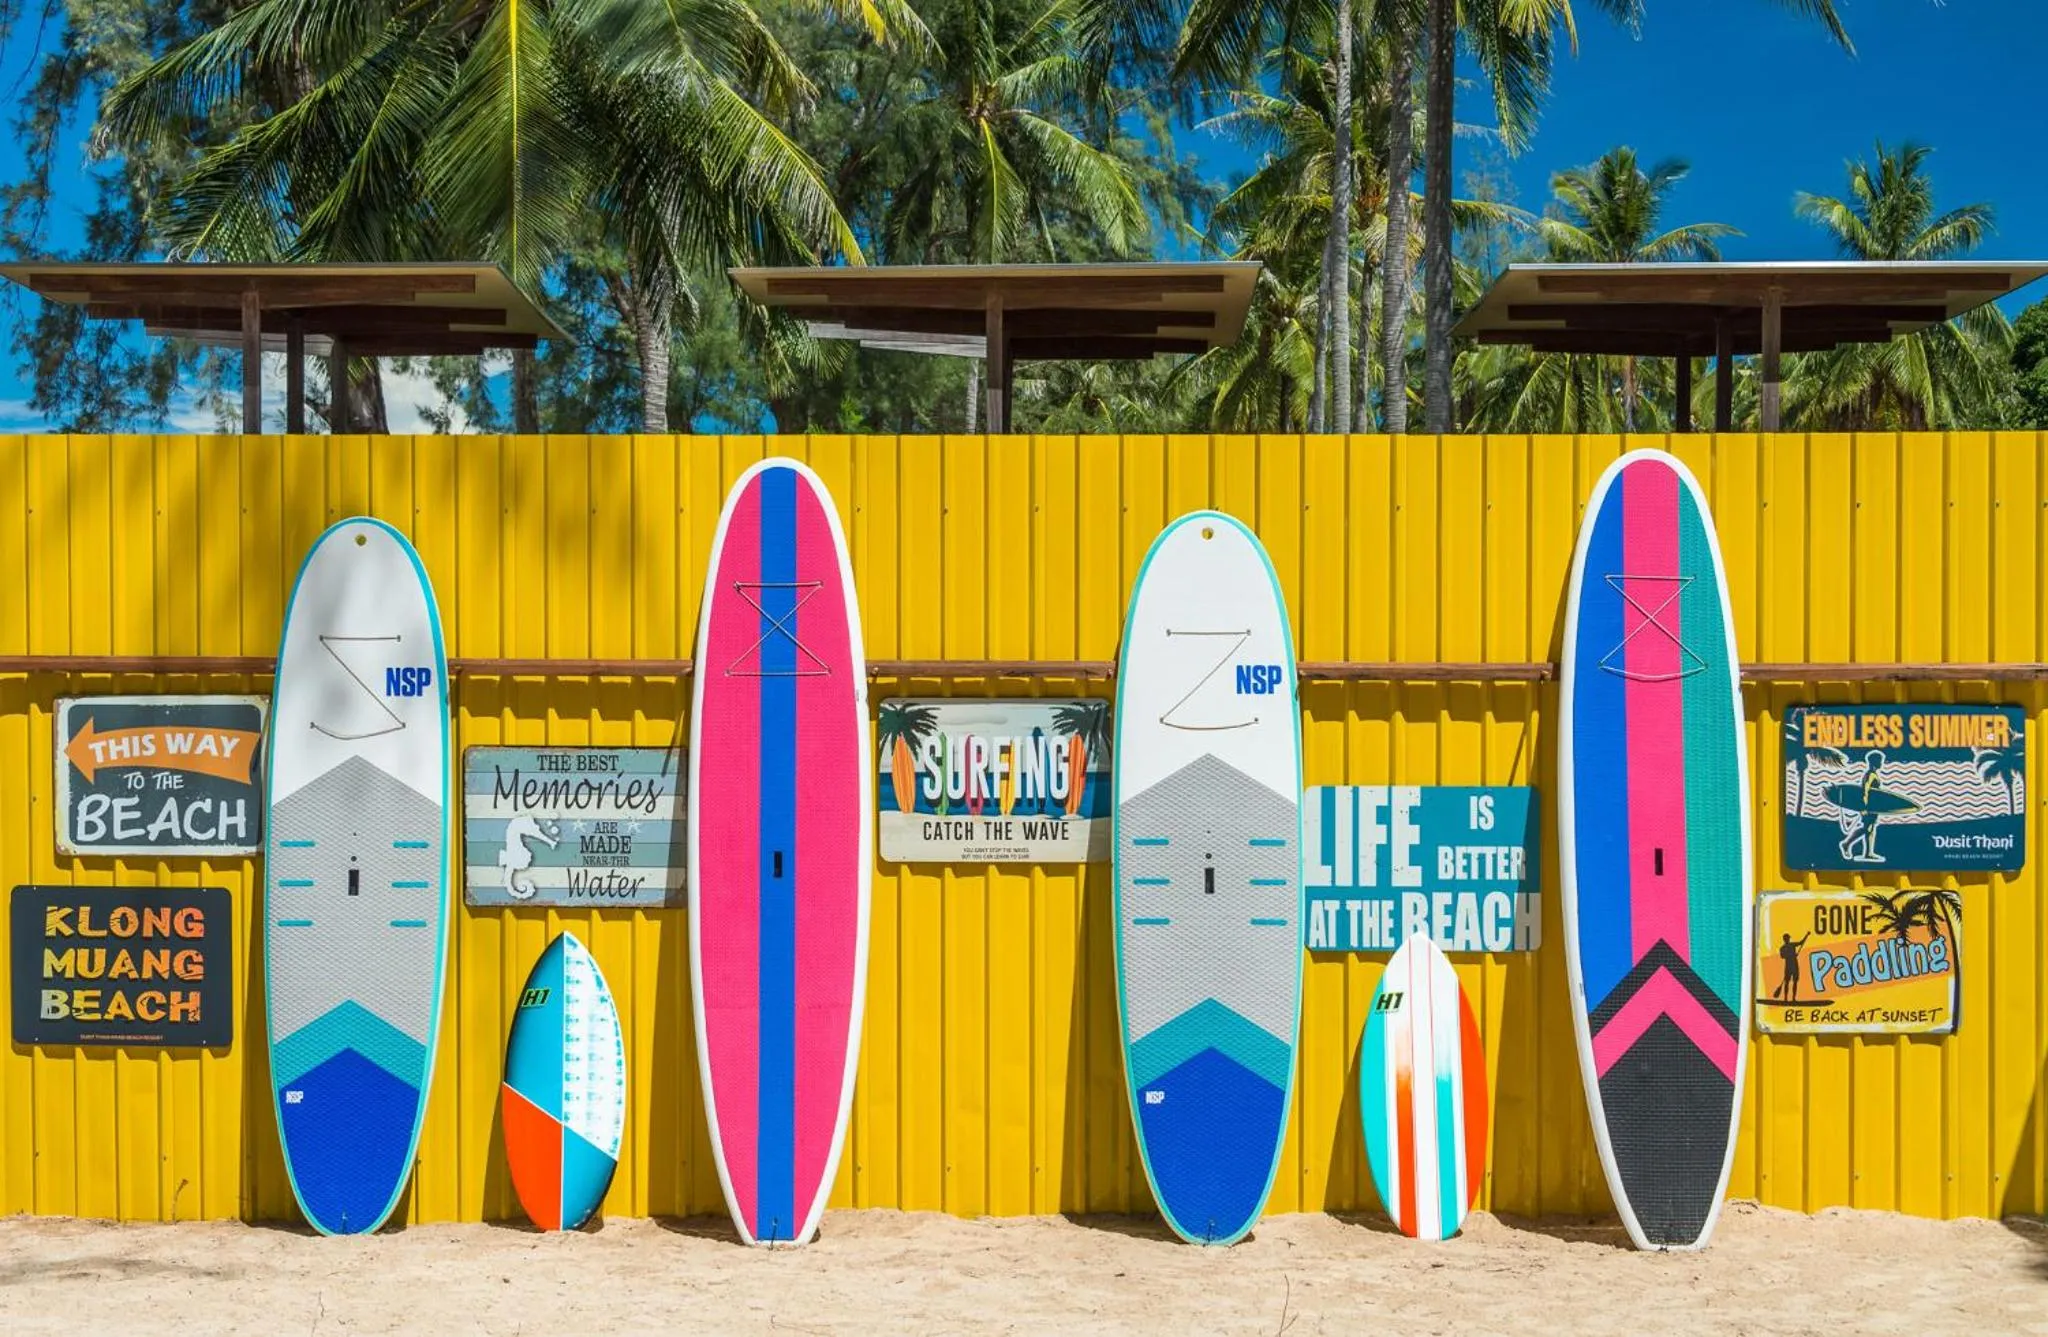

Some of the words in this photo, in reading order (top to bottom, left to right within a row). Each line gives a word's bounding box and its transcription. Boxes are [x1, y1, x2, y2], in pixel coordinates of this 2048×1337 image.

[385, 667, 431, 697] NSP
[1236, 664, 1282, 695] NSP
[1803, 713, 1904, 748] ENDLESS
[1908, 713, 2010, 748] SUMMER
[88, 733, 157, 763] THIS
[165, 732, 241, 759] WAY
[537, 754, 571, 772] THE
[575, 754, 619, 772] BEST
[123, 771, 145, 790] TO
[152, 771, 184, 790] THE
[922, 735, 1070, 803] SURFING
[493, 765, 665, 813] Memories
[76, 793, 248, 842] BEACH
[594, 822, 618, 834] ARE
[1469, 795, 1495, 831] IS
[580, 835, 632, 854] MADE
[923, 821, 974, 841] CATCH
[984, 821, 1013, 841] THE
[1023, 821, 1070, 841] WAVE
[1303, 785, 1422, 887] LIFE
[1931, 833, 1972, 848] Dusit
[1972, 833, 2014, 850] Thani
[583, 855, 608, 866] NEAR
[1438, 845, 1526, 880] BETTER
[566, 868, 645, 898] Water
[45, 905, 205, 938] KLONG
[1309, 900, 1340, 947] AT
[1346, 900, 1395, 947] THE
[1402, 891, 1542, 952] BEACH
[1814, 904, 1873, 935] GONE
[42, 948, 205, 981] MUANG
[1809, 936, 1950, 993] Paddling
[40, 989, 201, 1023] BEACH
[522, 988, 550, 1007] H1
[1375, 991, 1404, 1010] H1
[1784, 1009, 1804, 1022] BE
[1810, 1009, 1849, 1022] BACK
[1856, 1008, 1881, 1022] AT
[1881, 1008, 1943, 1022] SUNSET
[286, 1090, 304, 1104] NSP
[1146, 1090, 1165, 1104] NSP
